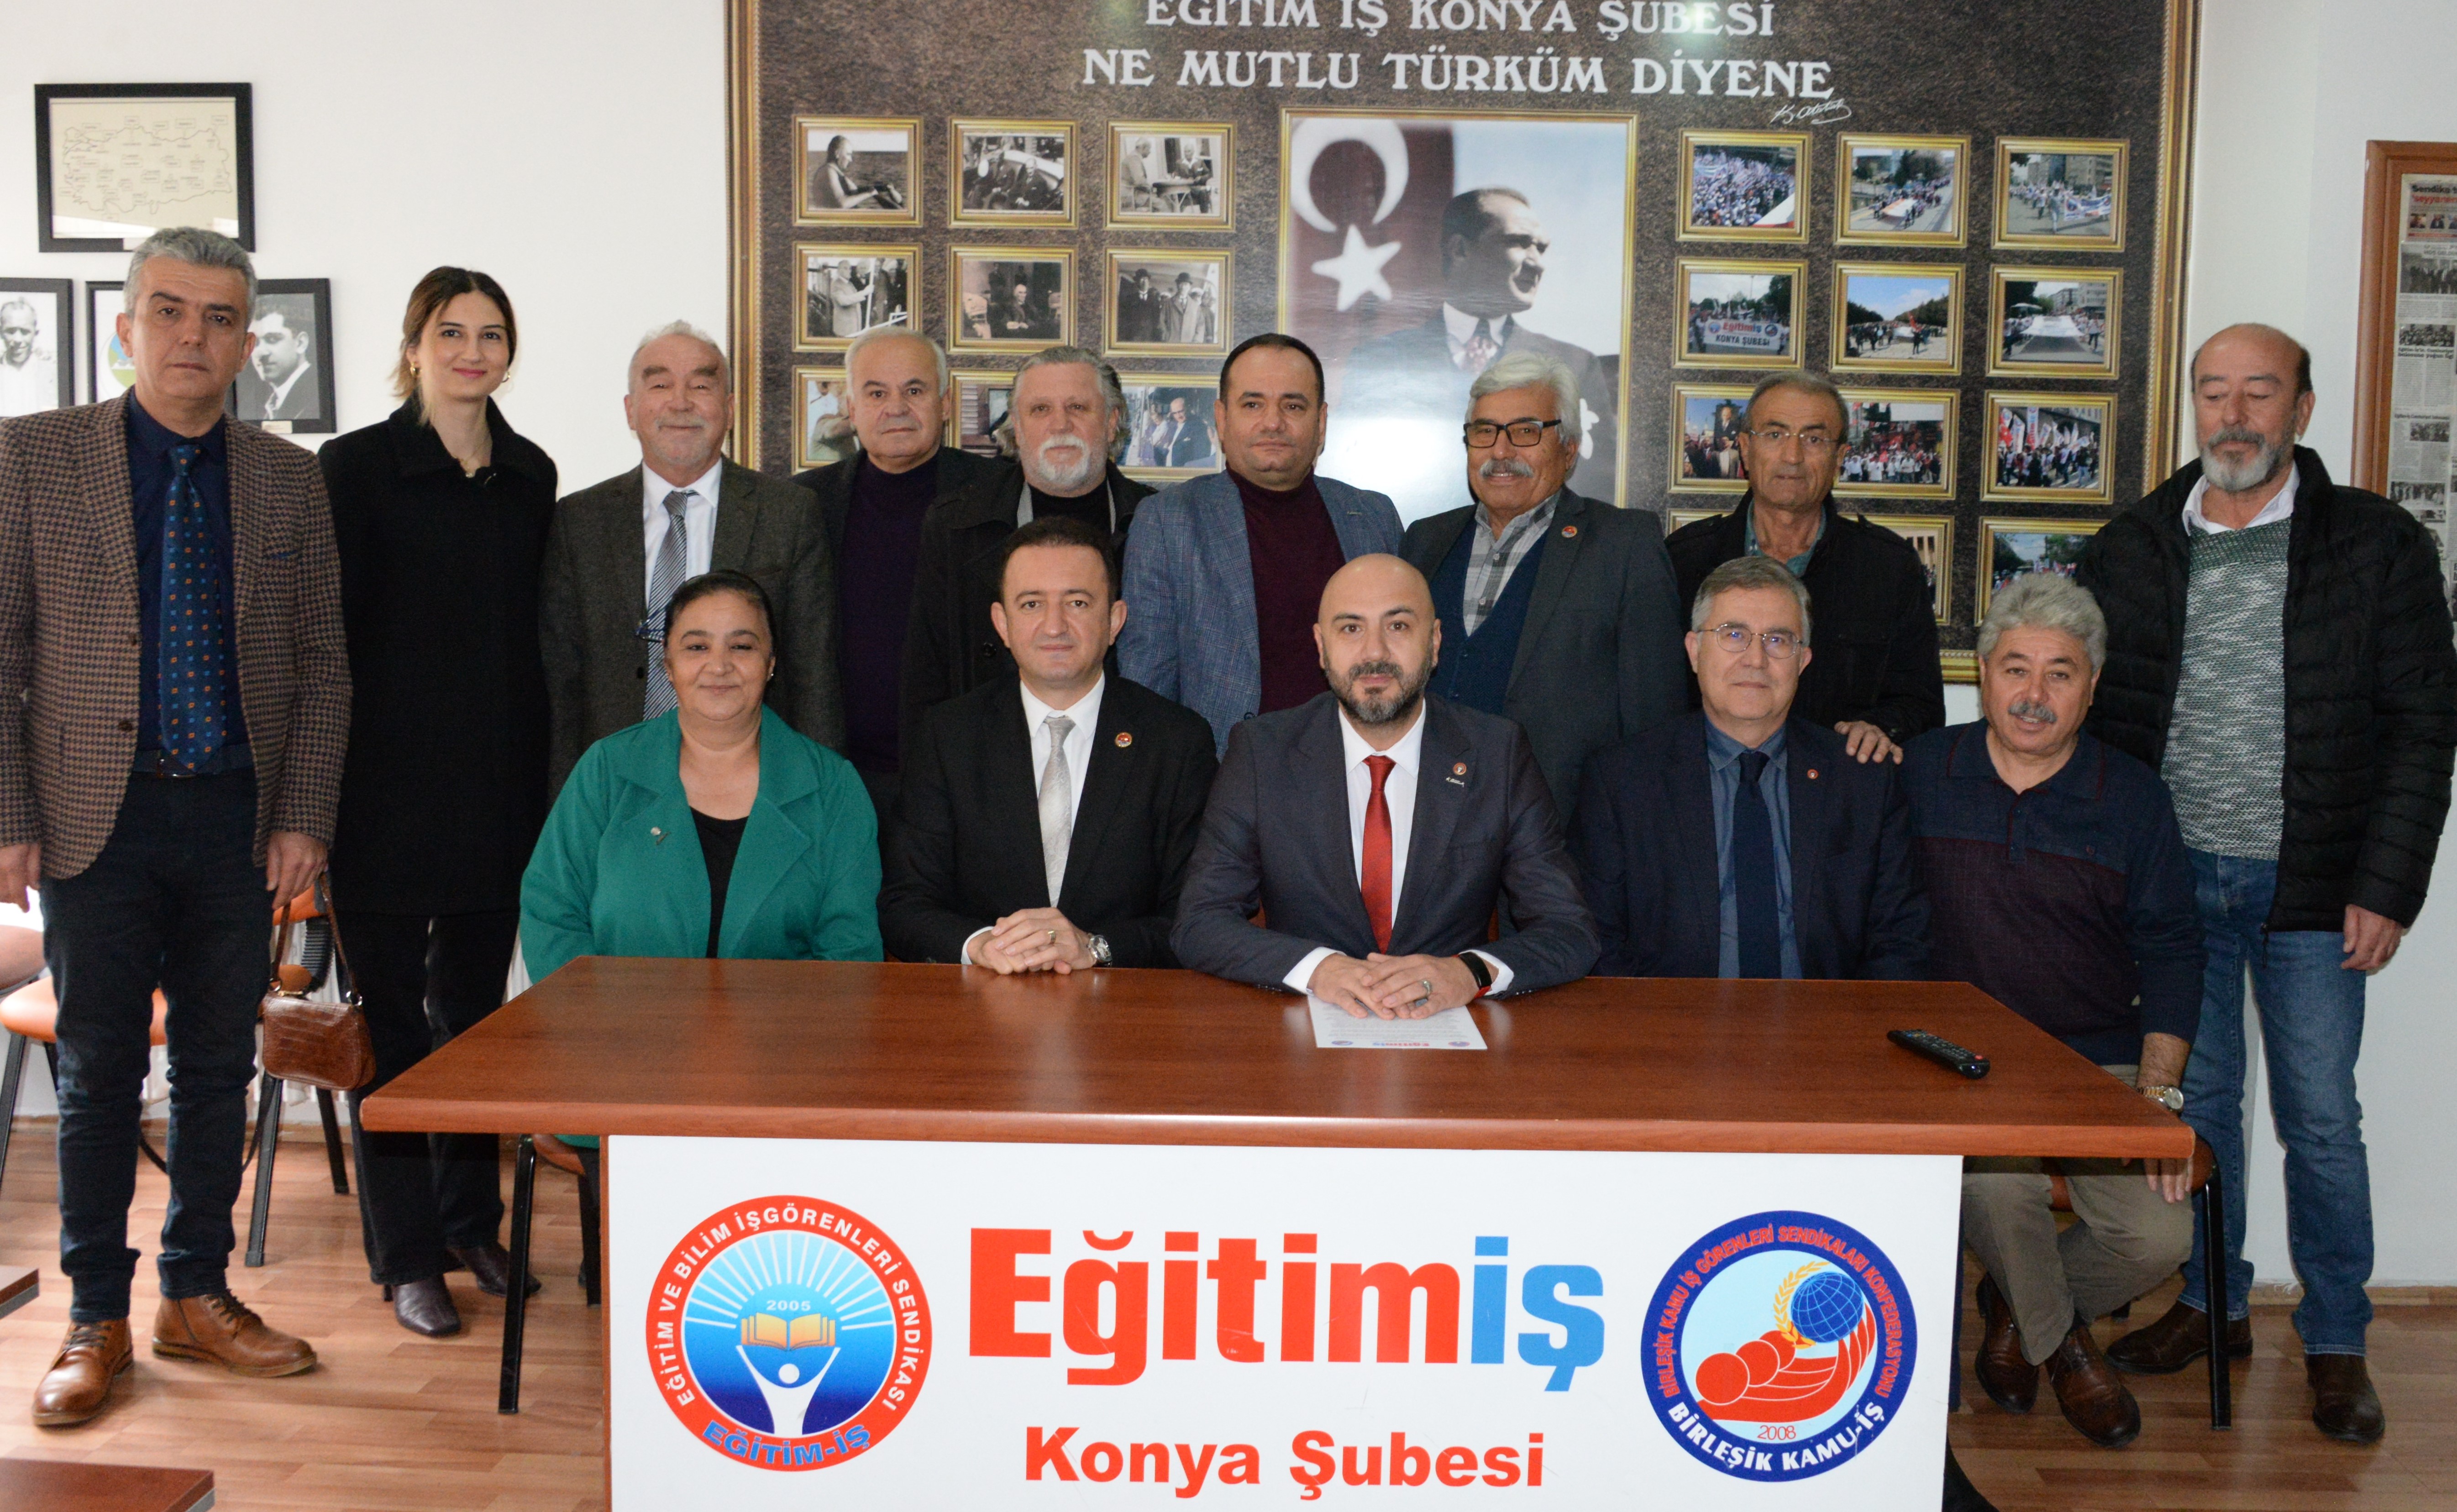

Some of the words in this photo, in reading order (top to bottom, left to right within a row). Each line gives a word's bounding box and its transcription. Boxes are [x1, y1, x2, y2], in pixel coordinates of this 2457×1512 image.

[1409, 0, 1577, 32] KONYA
[1083, 48, 1155, 87] NE
[1177, 50, 1360, 89] MUTLU
[1382, 45, 1608, 93] TÜRKÜM
[1631, 49, 1834, 99] DİYENE
[674, 1223, 732, 1279] BİLİM
[734, 1203, 902, 1275] İŞGÖRENLERİ
[1695, 1223, 1774, 1273] GÖRENLERİ
[1778, 1226, 1869, 1272] SENDİKALARI
[659, 1283, 682, 1311] VE
[766, 1299, 811, 1311] 2005
[1678, 1270, 1703, 1288] İŞ
[1659, 1285, 1689, 1328] KAMU
[1862, 1266, 1902, 1398] KONFEDERASYONU
[654, 1322, 695, 1406] EĞİTİM
[882, 1279, 924, 1411] SENDİKASI
[1653, 1331, 1680, 1398] BİRLEŞİK
[701, 1420, 871, 1466] EĞİTİM-İŞ
[1668, 1402, 1773, 1471] BİRLEŞİK
[1782, 1402, 1885, 1471] KAMU-İŞ
[1757, 1425, 1797, 1441] 2008
[1025, 1426, 1260, 1499] Konya
[1290, 1429, 1544, 1502] Şubesi
